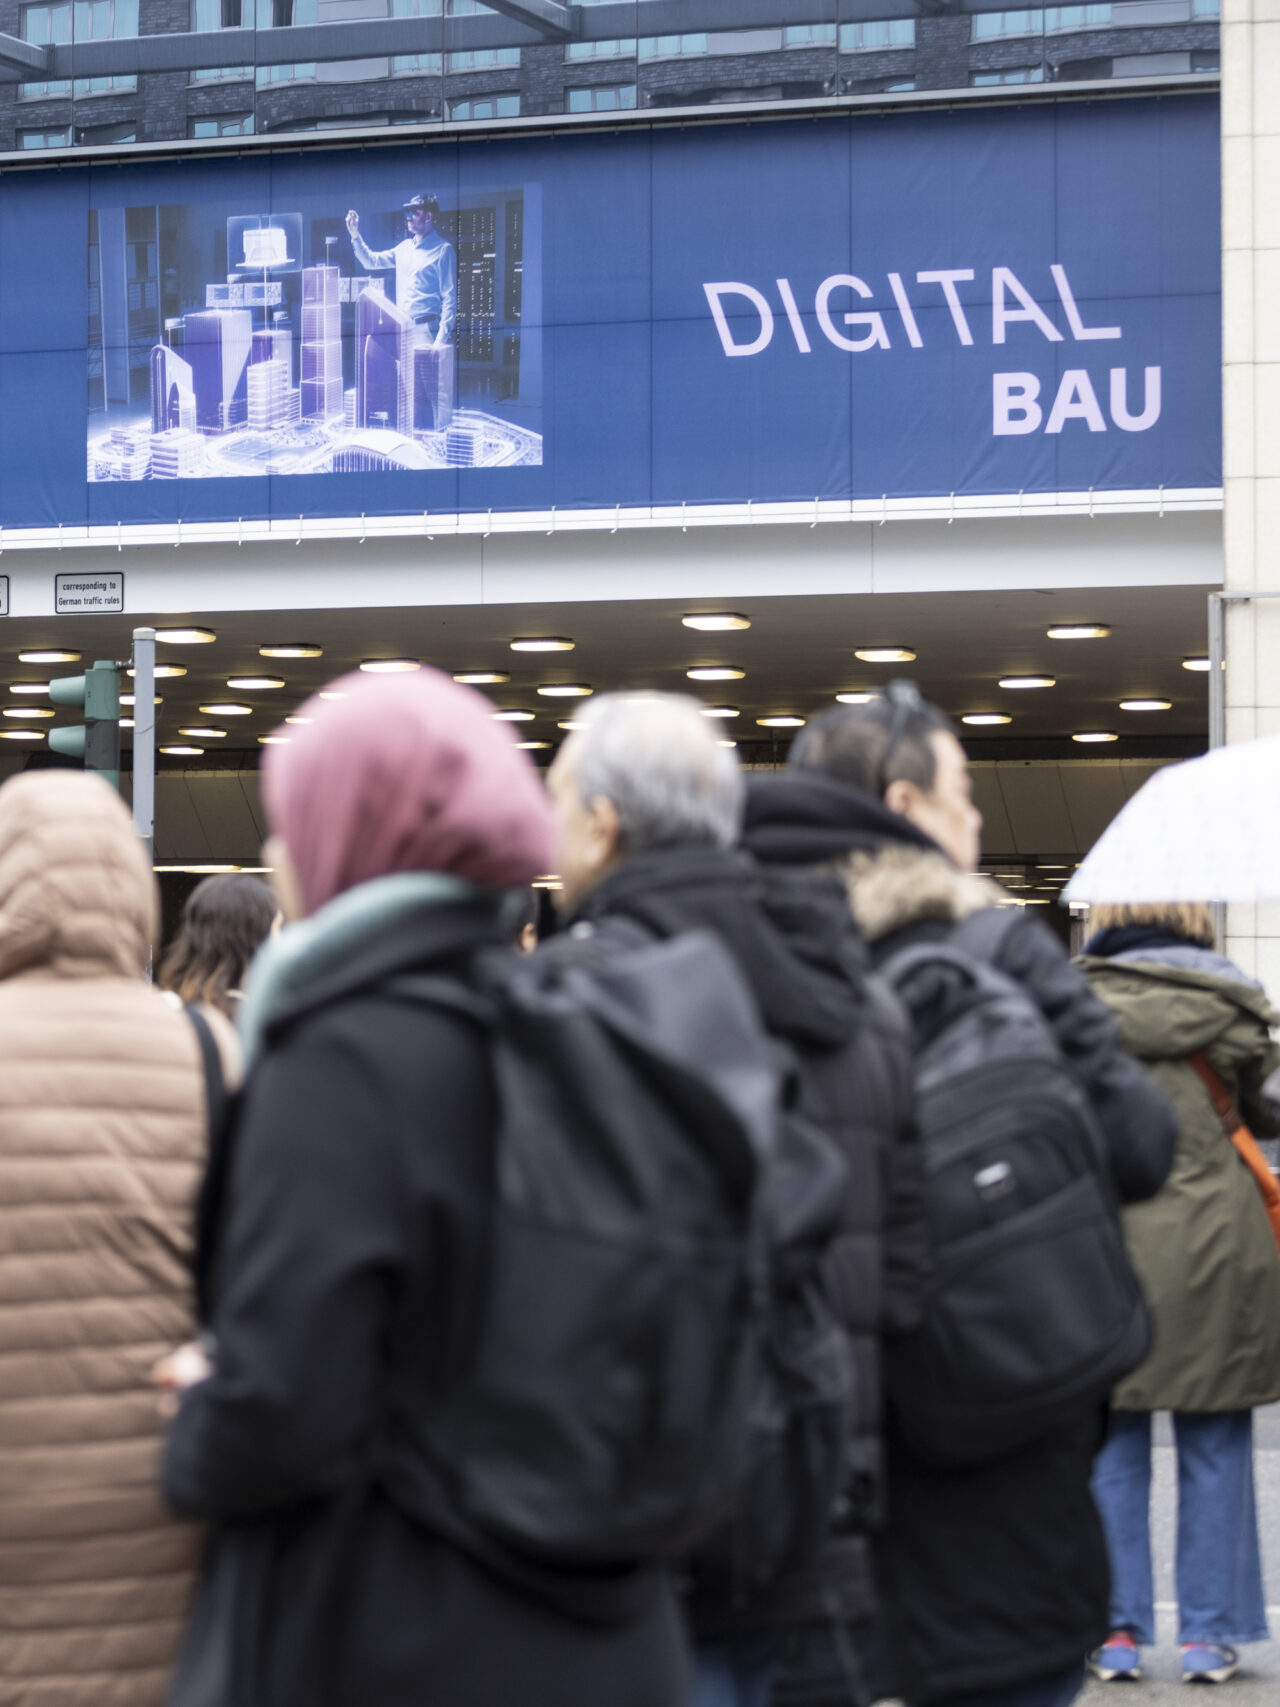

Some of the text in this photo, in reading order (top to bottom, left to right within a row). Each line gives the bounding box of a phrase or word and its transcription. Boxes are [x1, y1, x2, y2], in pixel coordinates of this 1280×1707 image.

[702, 264, 1122, 357] DIGITAL
[992, 366, 1162, 436] BAU
[58, 595, 120, 606] German traffic rules
[62, 581, 116, 592] corresponding to
